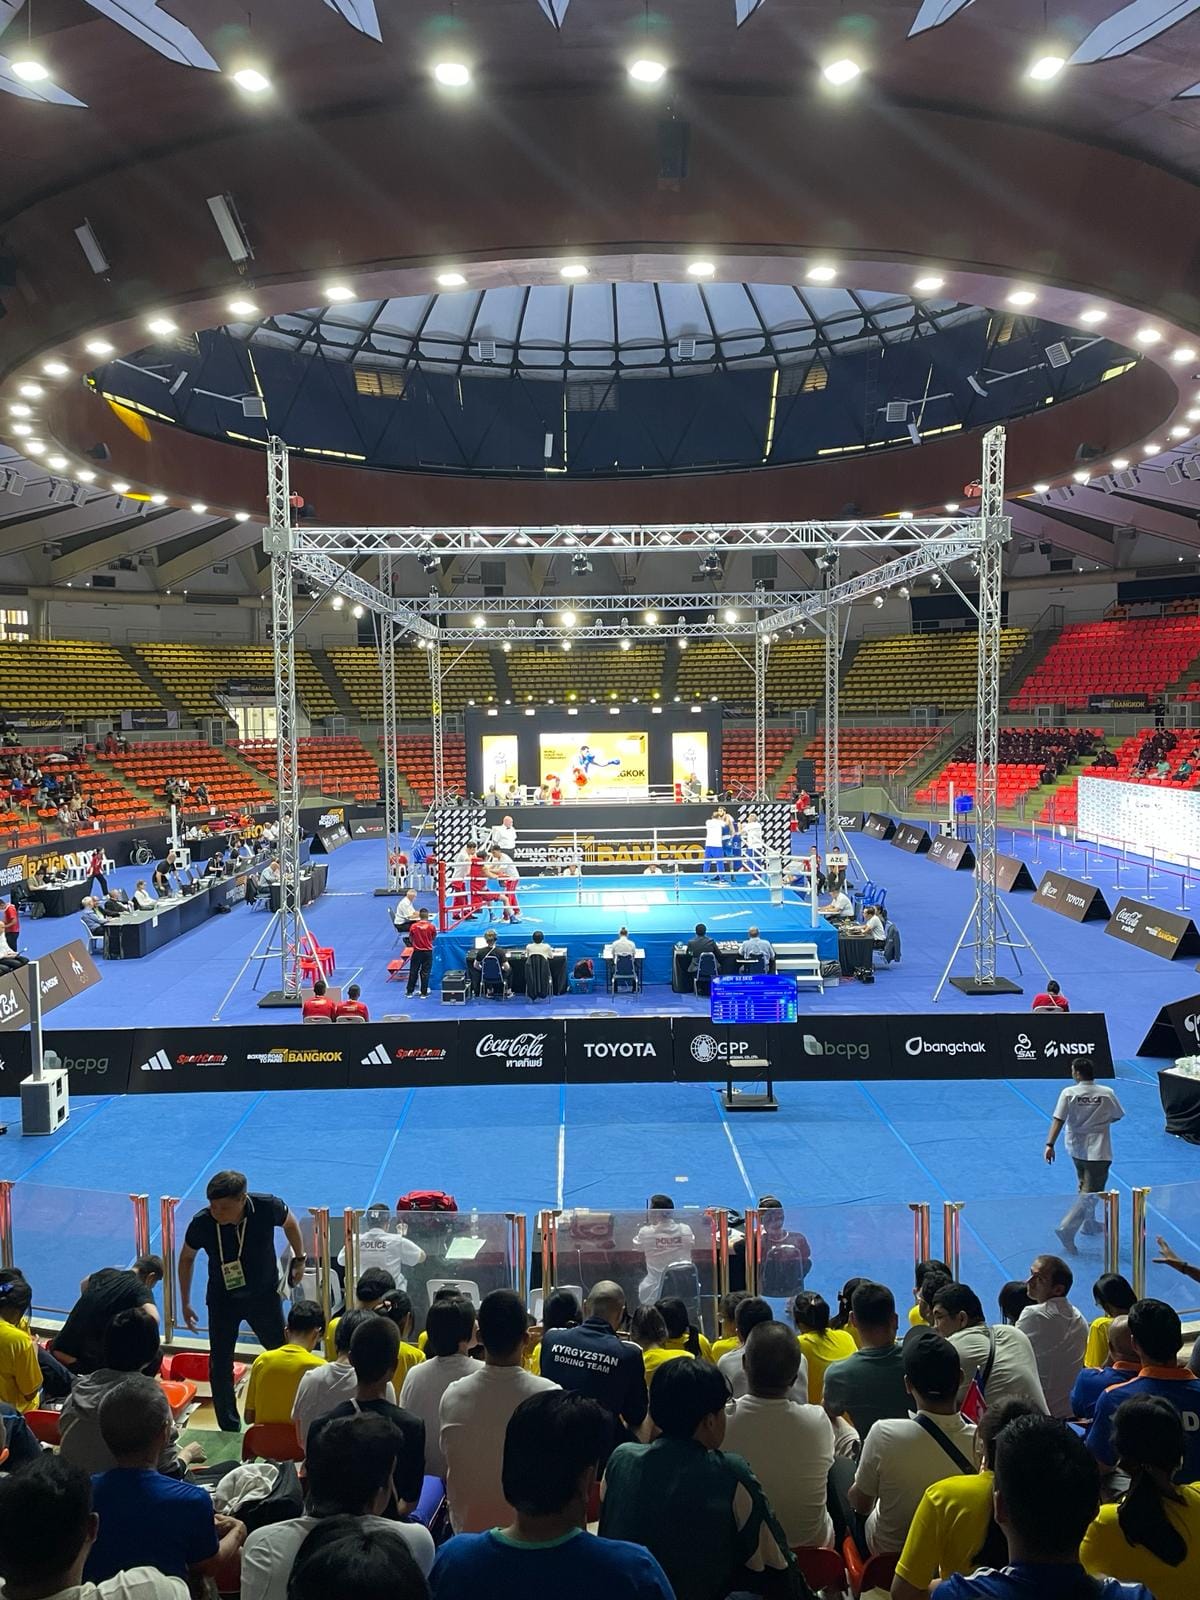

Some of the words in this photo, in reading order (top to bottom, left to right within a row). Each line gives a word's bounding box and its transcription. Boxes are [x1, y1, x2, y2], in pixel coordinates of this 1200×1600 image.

[1065, 893, 1086, 908] TOYOTA
[476, 1033, 547, 1058] Coca-Cola
[583, 1043, 657, 1058] TOYOTA
[717, 1042, 749, 1055] GPP
[825, 1041, 870, 1060] bcpg
[923, 1041, 986, 1056] bangchak
[1060, 1043, 1095, 1054] NSDF
[288, 1052, 343, 1063] BANGKOK
[63, 1056, 109, 1075] bcpg
[360, 1240, 387, 1249] POLICE
[655, 1236, 682, 1246] POLICE
[551, 1344, 619, 1367] KYRGYZSTAN
[554, 1354, 585, 1368] BOXING
[587, 1361, 610, 1374] TEAM
